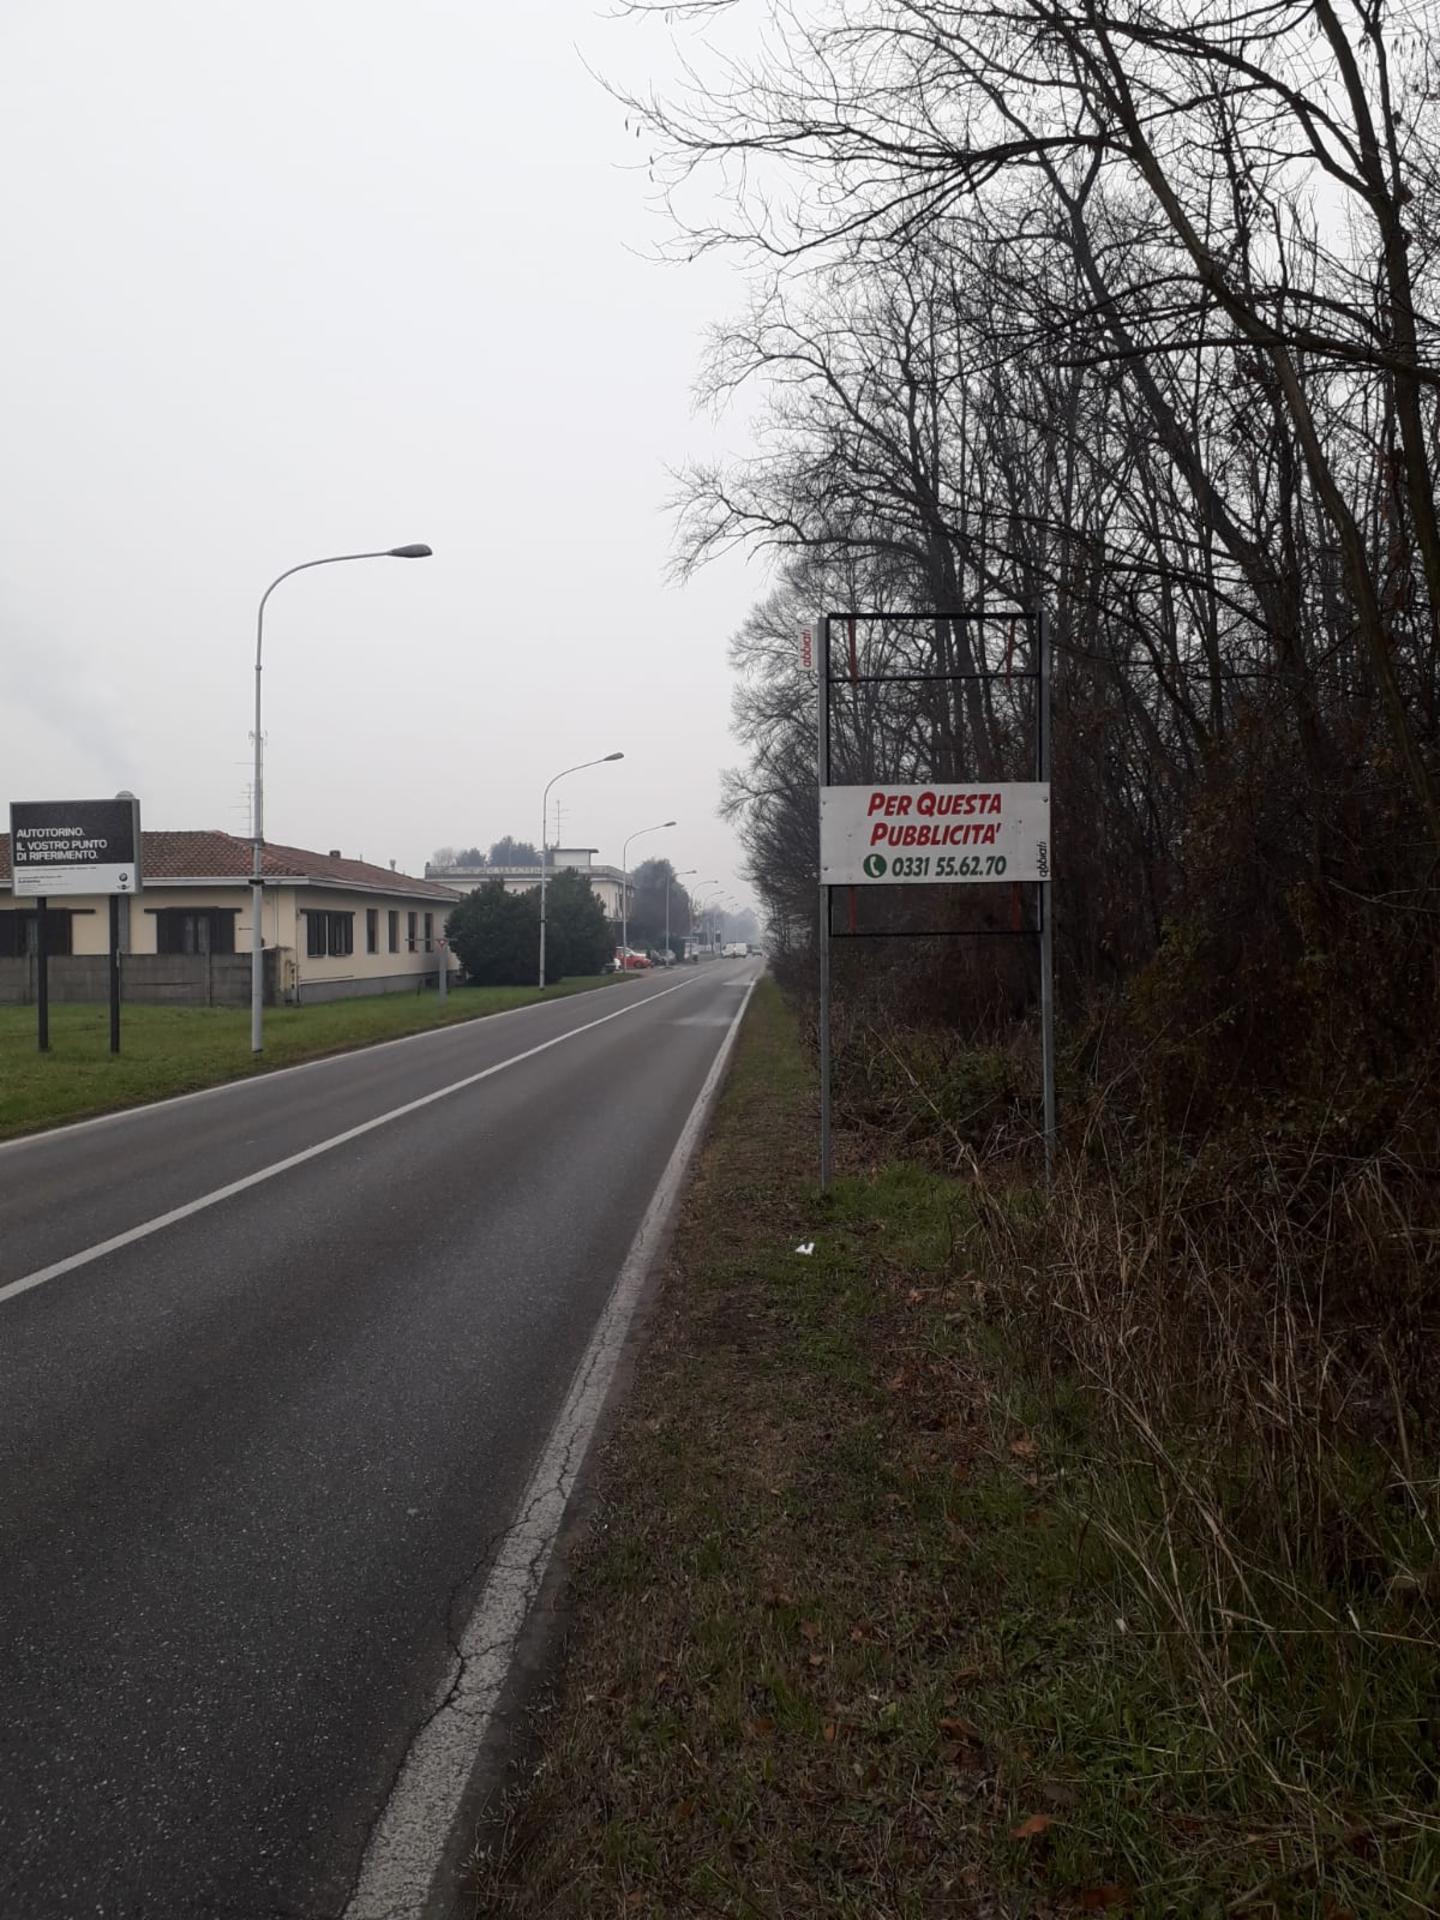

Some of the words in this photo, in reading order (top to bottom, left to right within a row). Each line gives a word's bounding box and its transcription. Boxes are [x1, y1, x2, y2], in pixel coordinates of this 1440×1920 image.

[867, 792, 912, 817] PER
[917, 791, 1002, 817] QUESTA
[16, 842, 25, 851] IL
[27, 840, 70, 850] VOSTRO
[72, 839, 108, 849] PUNTO
[16, 852, 27, 861] DI
[892, 857, 930, 877] 0331
[935, 855, 1007, 877] 55.62.70
